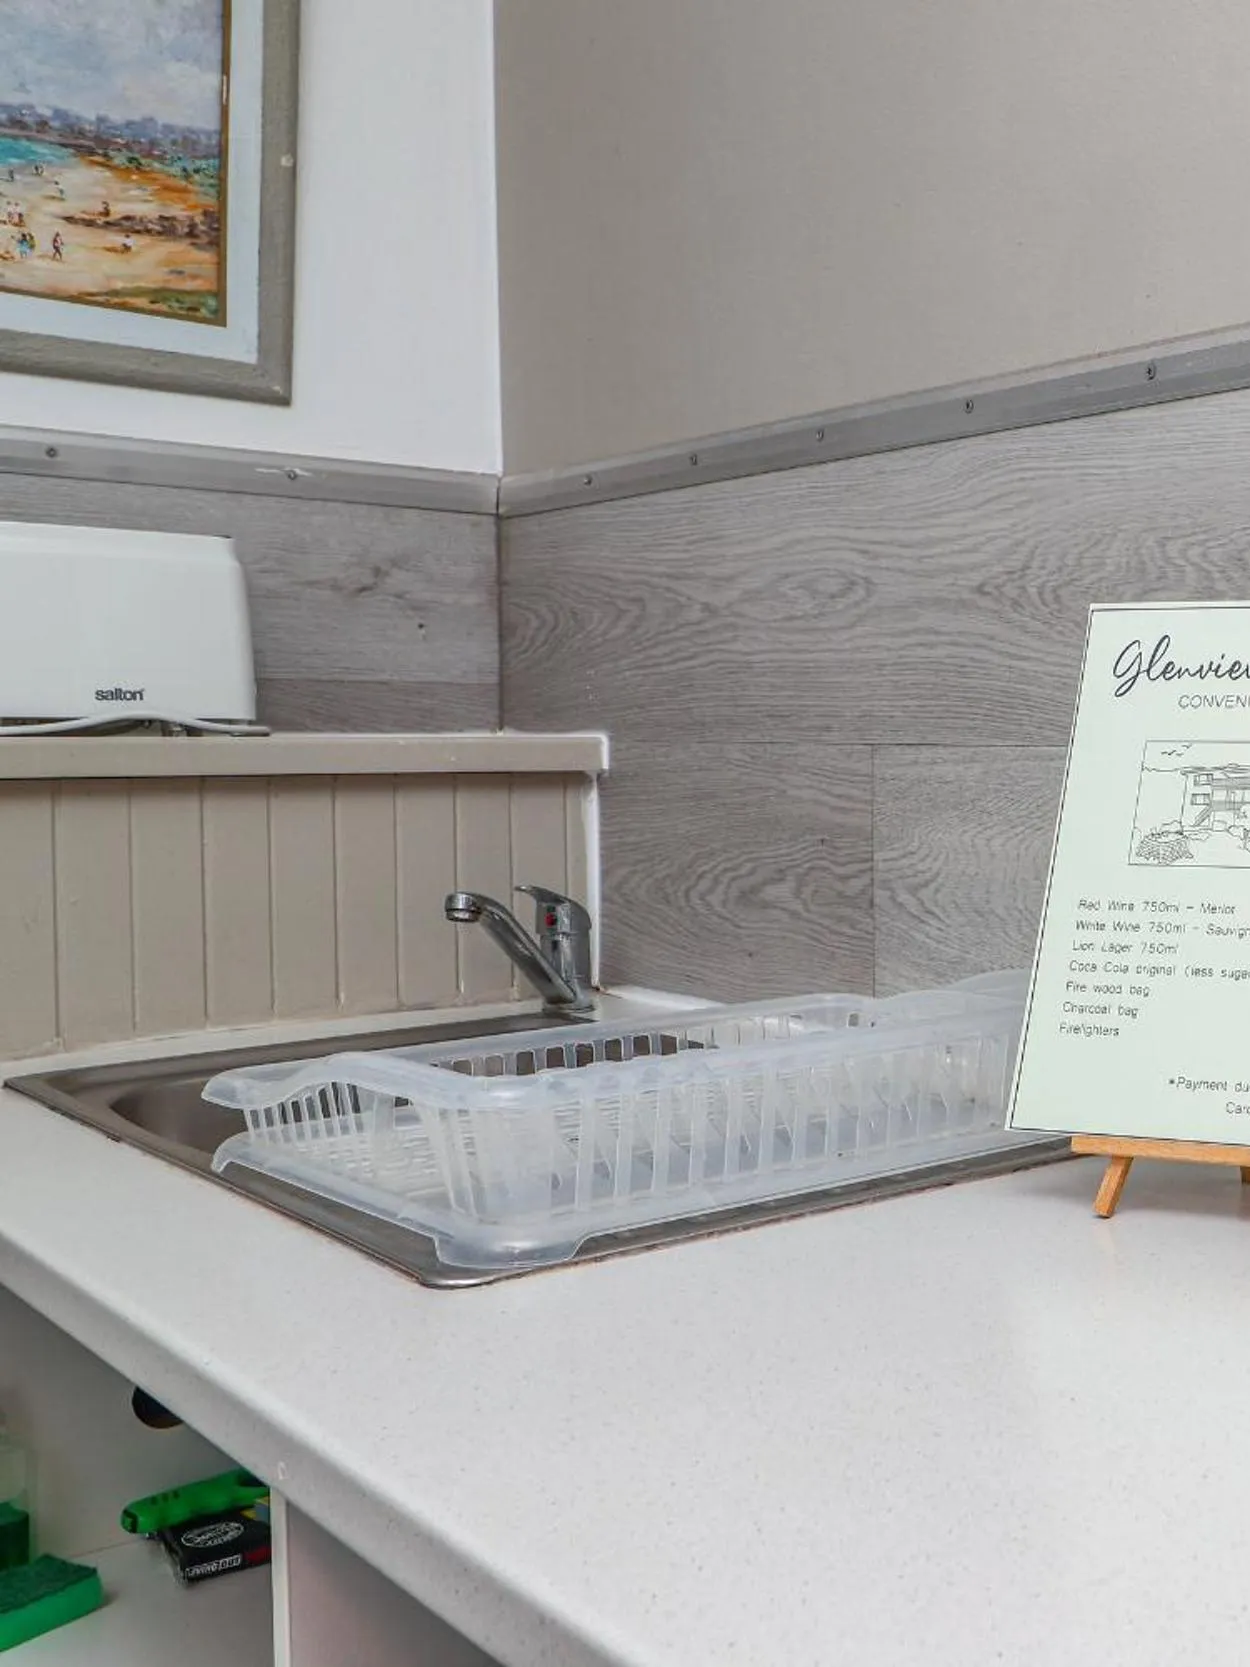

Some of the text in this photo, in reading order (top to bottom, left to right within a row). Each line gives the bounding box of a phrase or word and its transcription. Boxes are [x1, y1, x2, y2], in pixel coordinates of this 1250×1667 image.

[94, 687, 145, 701] salton
[1077, 898, 1101, 911] Red
[1108, 900, 1135, 912] Wine
[1113, 921, 1141, 932] Wine
[1101, 941, 1134, 954] Lager
[1069, 960, 1098, 972] Coca
[1104, 961, 1129, 974] Cola
[1065, 980, 1151, 998] Fire wood bag
[1063, 1001, 1140, 1019] Charcoal bag
